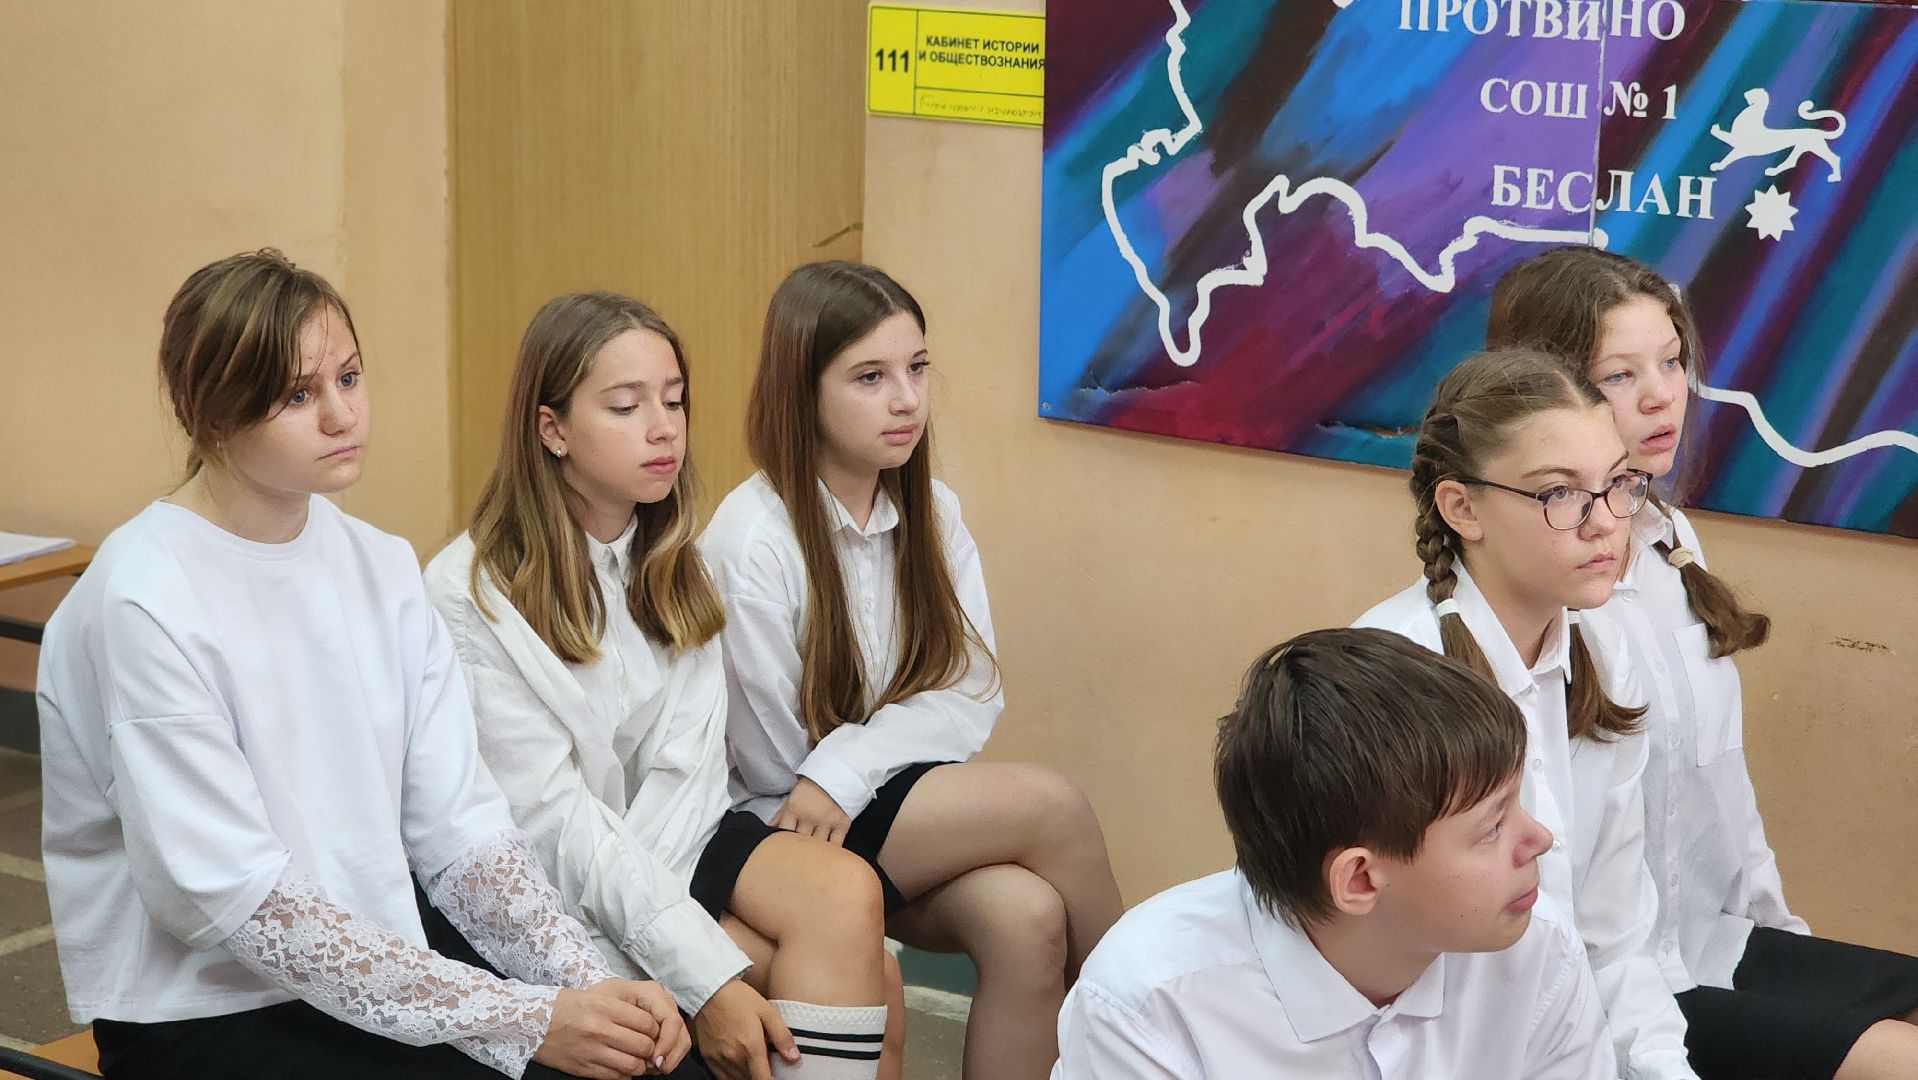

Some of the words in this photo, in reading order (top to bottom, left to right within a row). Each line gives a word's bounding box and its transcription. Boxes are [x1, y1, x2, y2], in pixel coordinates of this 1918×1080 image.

[1399, 0, 1686, 42] ПРОТВИНО
[875, 48, 909, 73] 111
[918, 51, 926, 61] И
[930, 52, 1045, 71] ОБЩЕСТВОЗНАНИЯ
[926, 35, 980, 50] КАБИНЕТ
[982, 40, 1040, 54] ИСТОРИИ
[1480, 78, 1587, 119] СОШ
[1603, 81, 1648, 118] №
[1662, 84, 1678, 119] 1
[1491, 164, 1717, 220] БЕСЛАН
